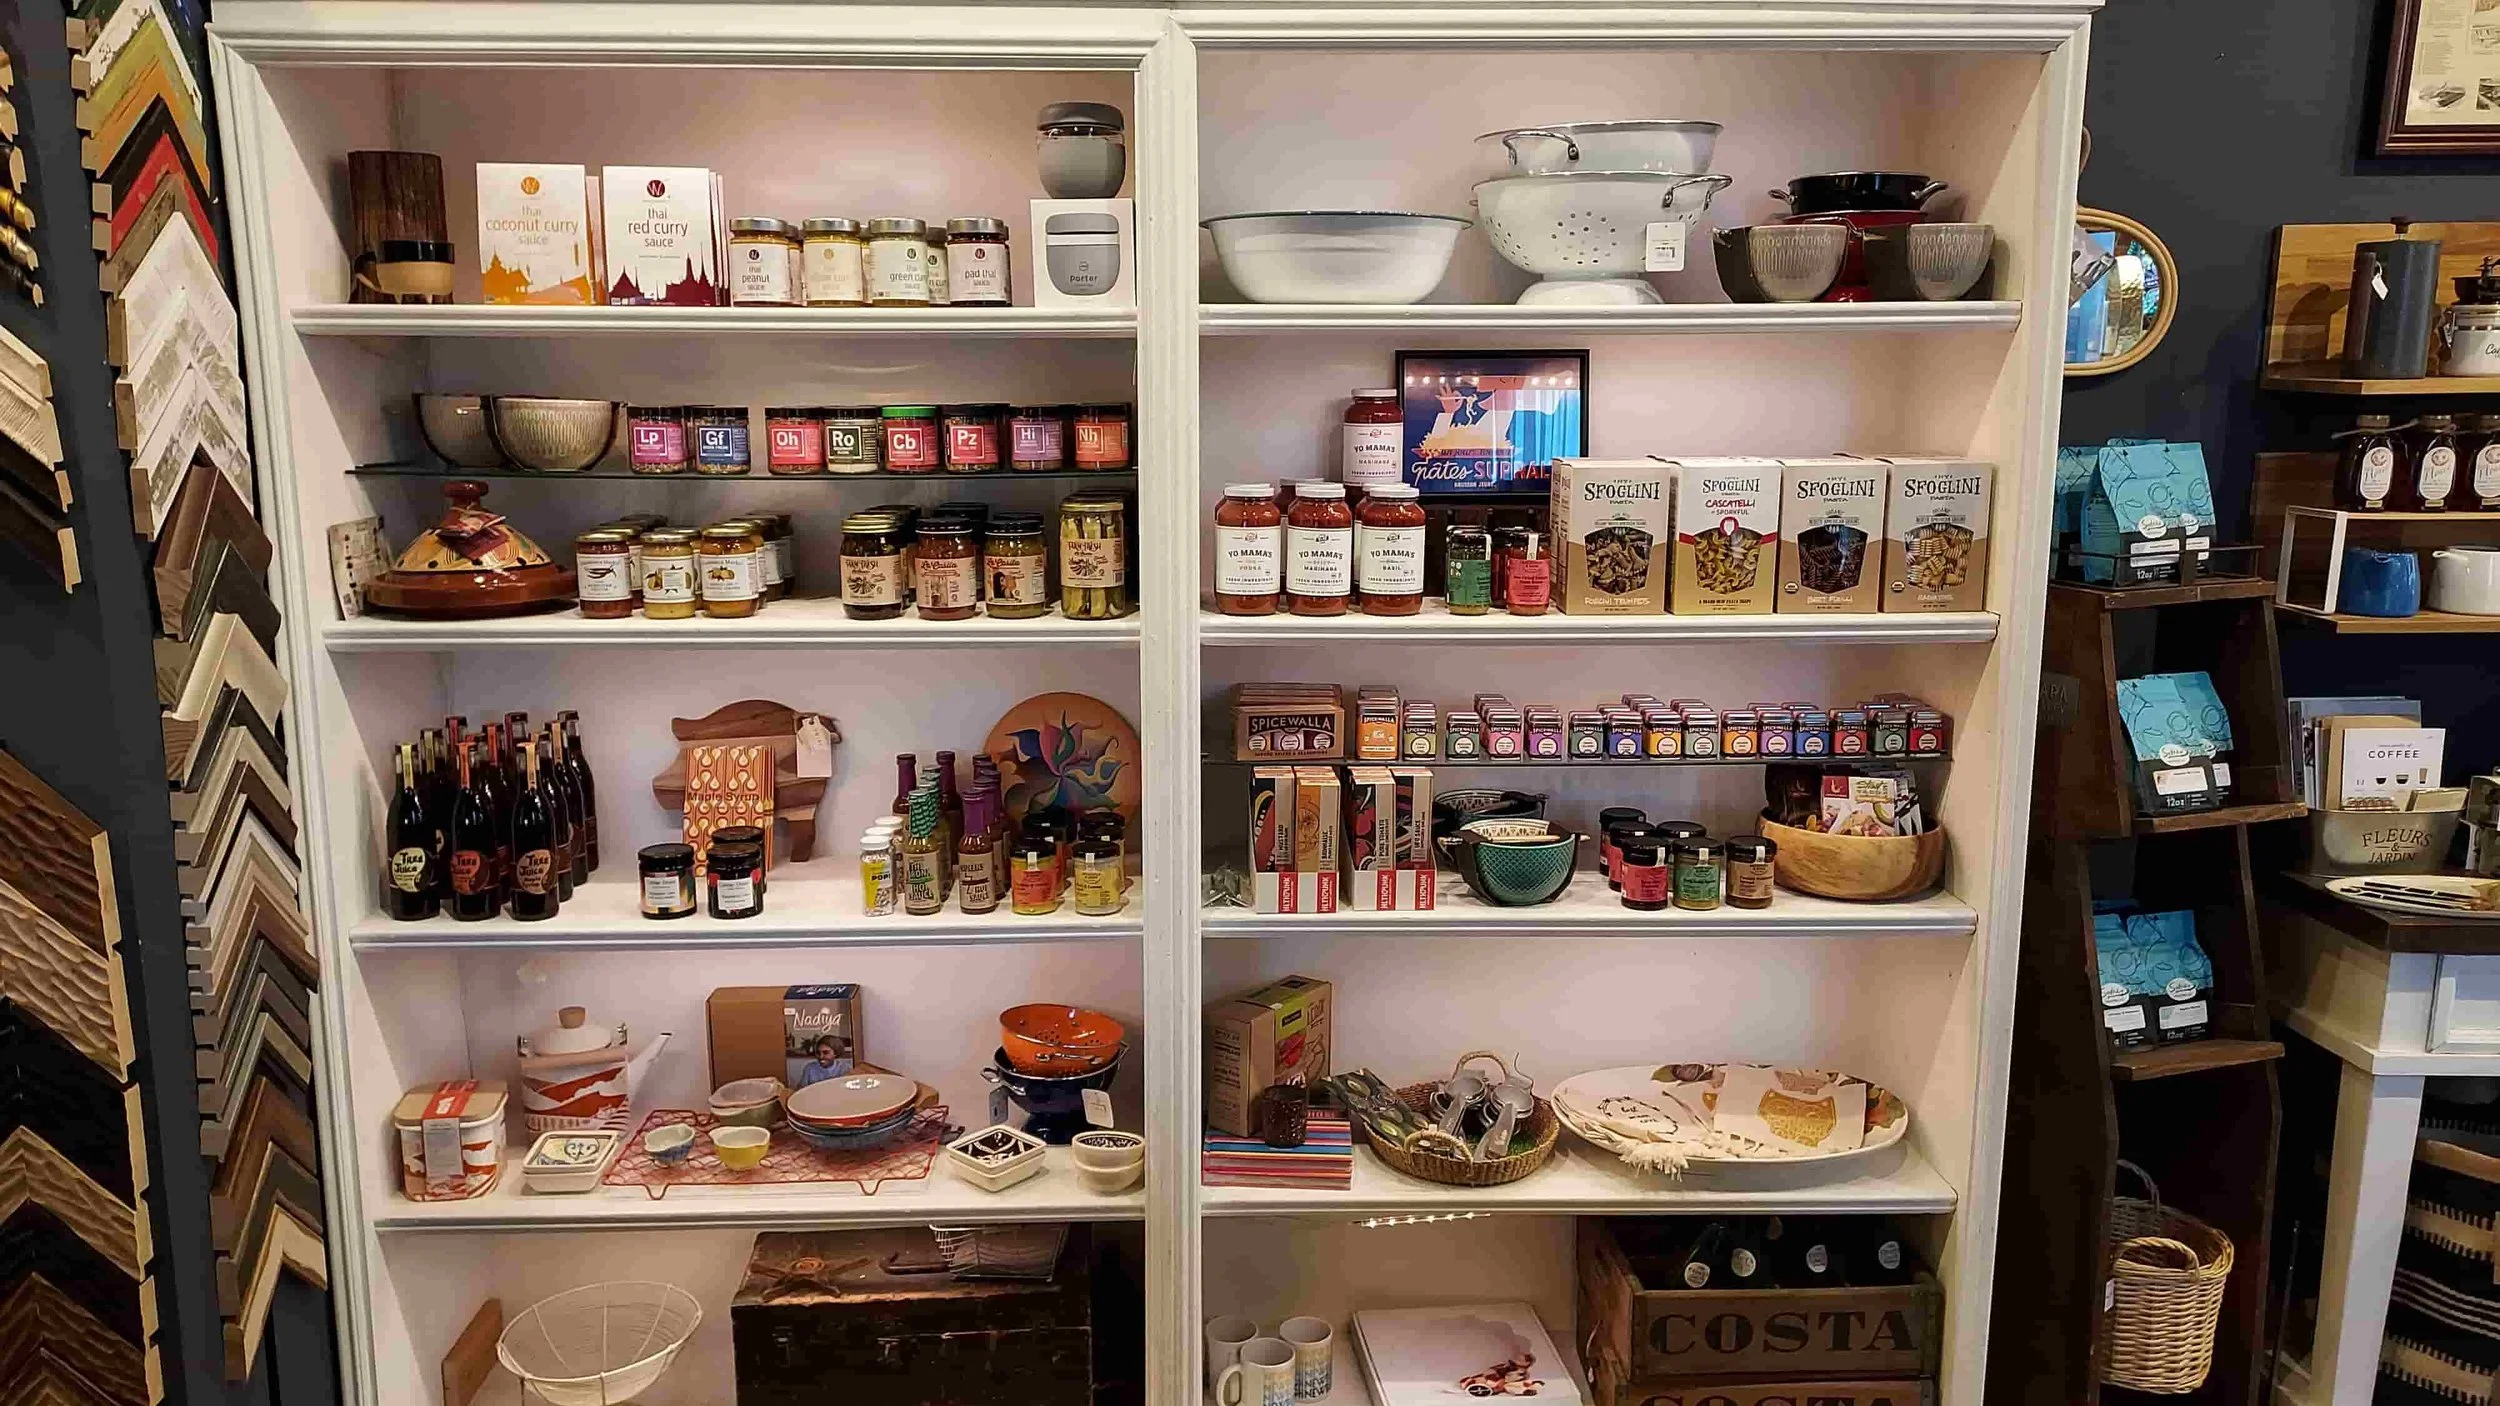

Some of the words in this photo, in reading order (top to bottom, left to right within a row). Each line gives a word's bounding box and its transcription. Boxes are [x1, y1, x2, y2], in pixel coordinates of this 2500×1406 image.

[648, 209, 667, 219] thai
[486, 219, 540, 232] coconut
[544, 220, 578, 235] curry
[628, 221, 651, 234] red
[654, 222, 688, 236] curry
[518, 235, 548, 245] sauce
[645, 237, 673, 247] sauce
[742, 274, 770, 283] peanut
[890, 272, 913, 282] green
[965, 269, 980, 279] pad
[982, 269, 996, 278] thai
[1069, 275, 1098, 283] porter
[641, 430, 659, 444] Lp
[706, 431, 724, 445] Gf
[776, 431, 798, 446] Oh
[832, 431, 855, 446] Ro
[957, 430, 977, 445] Pz
[1020, 427, 1036, 440] Hi
[893, 433, 916, 449] Cb
[1354, 445, 1363, 453] YO
[1412, 460, 1473, 487] pâtes
[1584, 482, 1660, 501] SFOGLINI
[1702, 478, 1760, 494] SFOGLINI
[1797, 479, 1876, 499] SFOGLINI
[1904, 477, 1981, 498] SFOGLINI
[1251, 715, 1331, 732] SPICEWALLA
[2368, 750, 2420, 759] COFFEE
[725, 792, 760, 806] Syrup
[2362, 828, 2432, 847] FLEURS
[2390, 842, 2400, 852] &
[2368, 852, 2416, 865] JARDIN
[793, 1008, 843, 1033] Nadiya
[1650, 1309, 1918, 1355] COSTA
